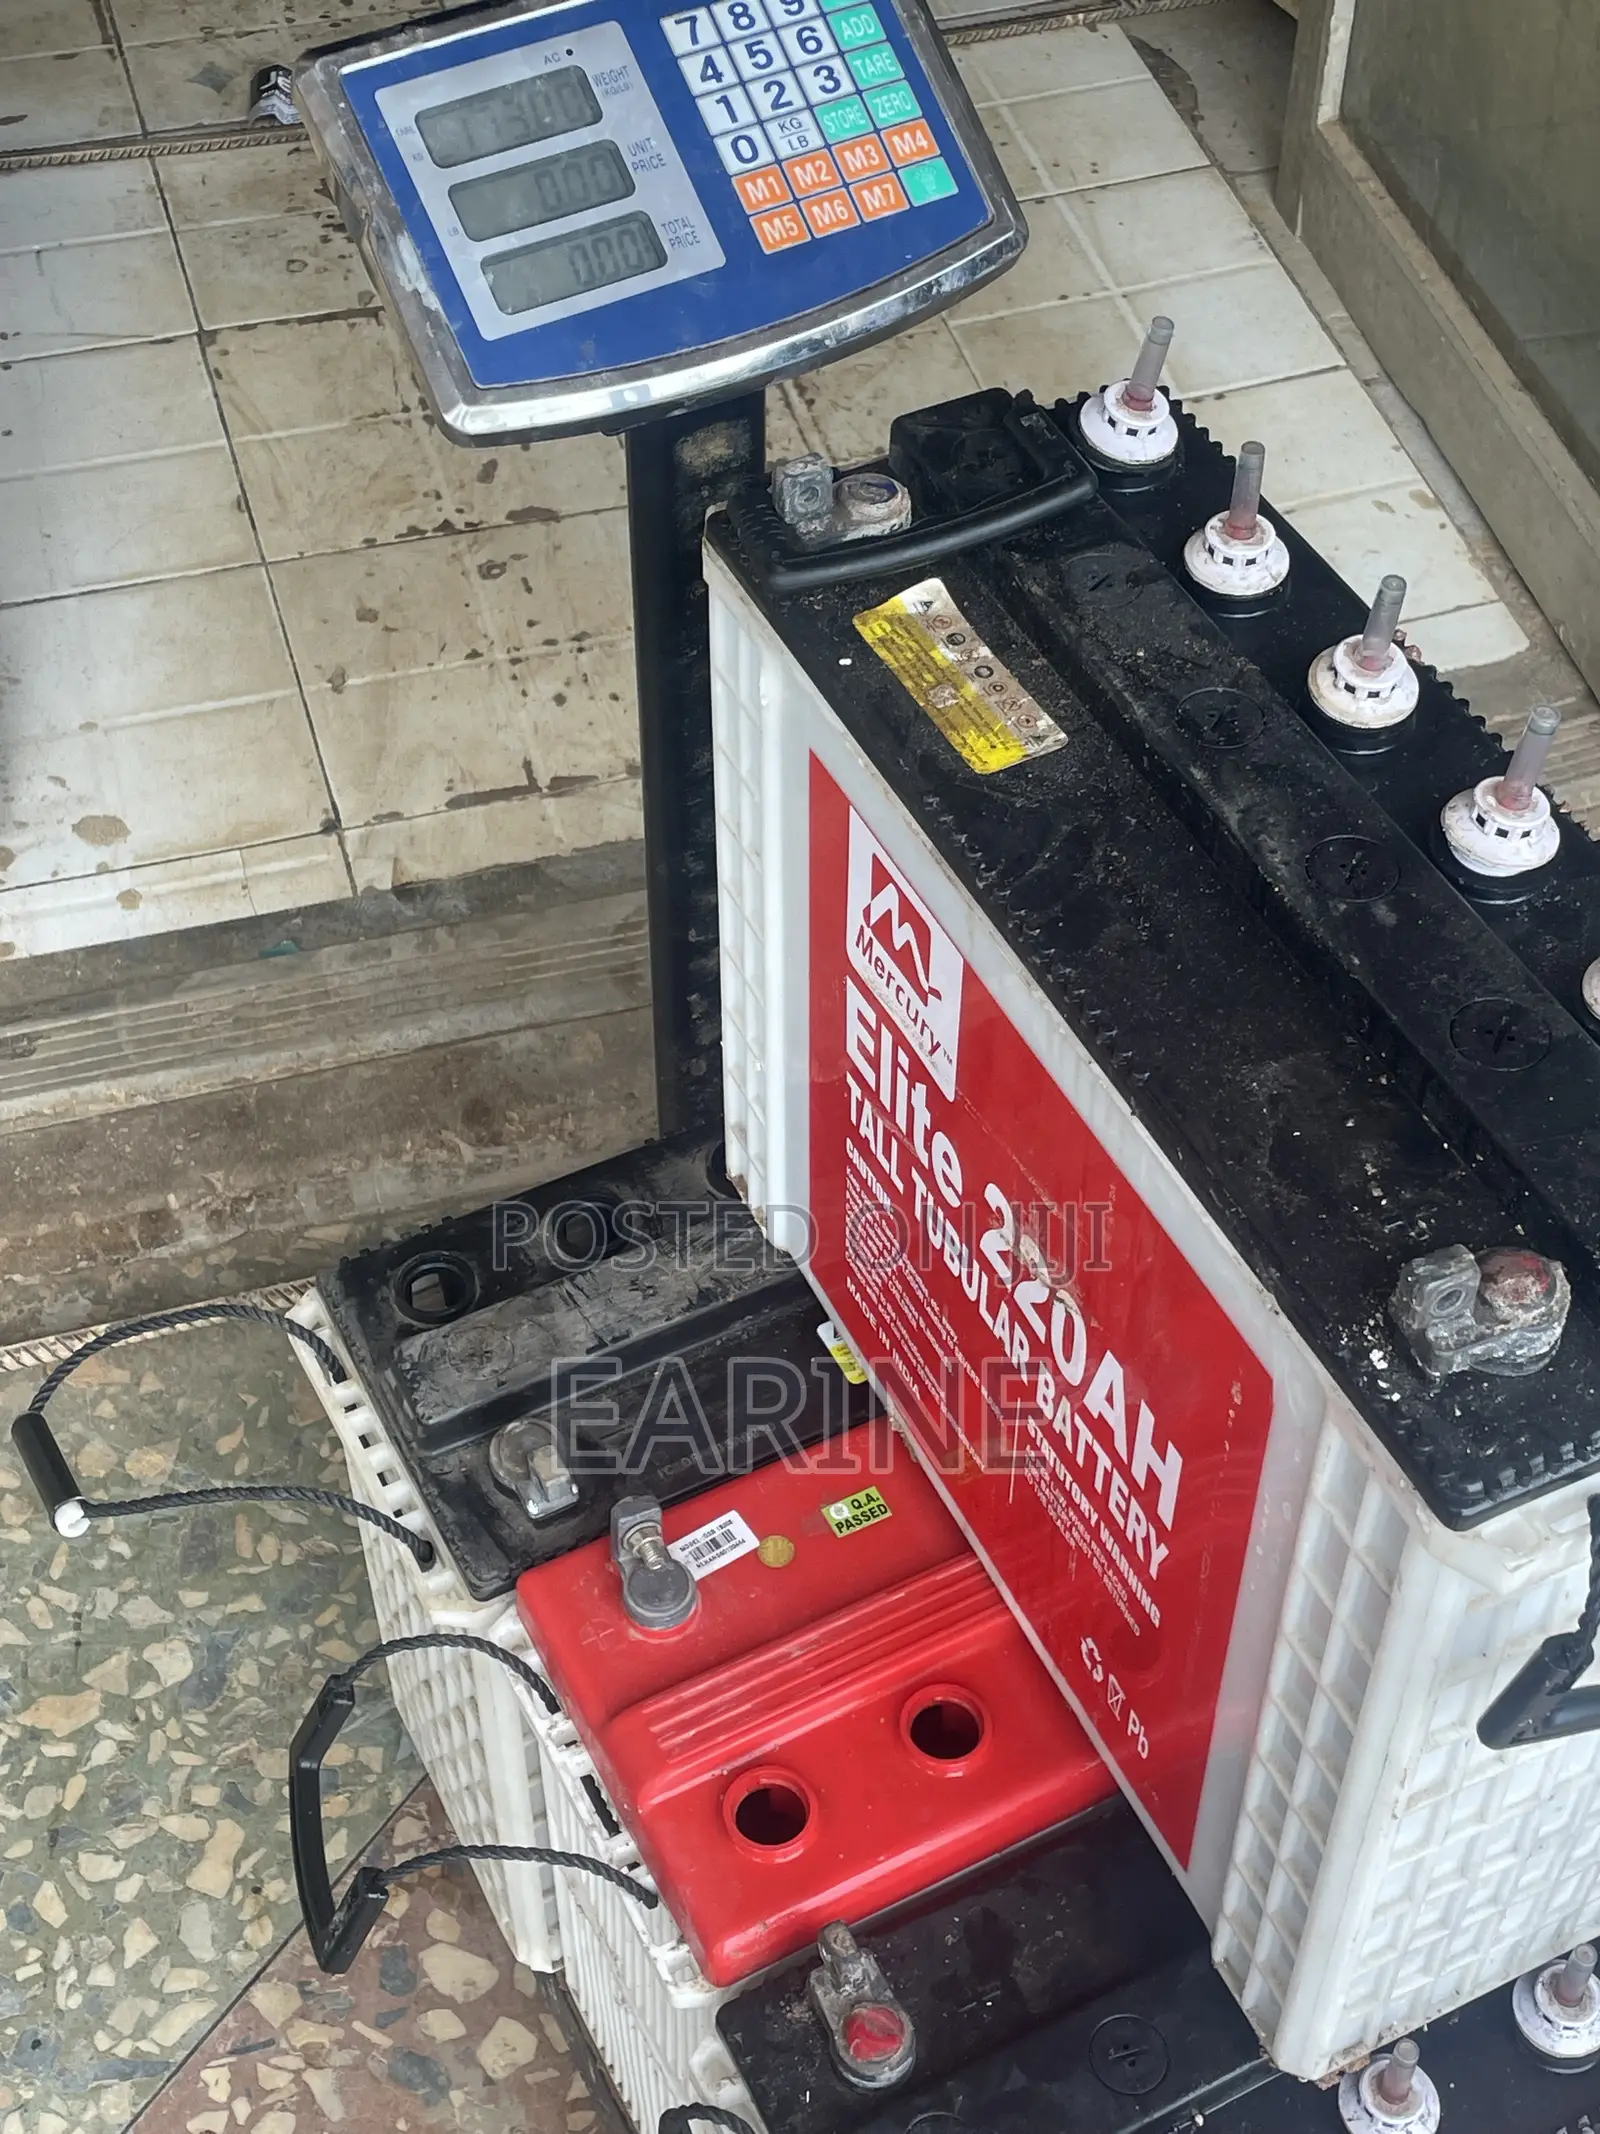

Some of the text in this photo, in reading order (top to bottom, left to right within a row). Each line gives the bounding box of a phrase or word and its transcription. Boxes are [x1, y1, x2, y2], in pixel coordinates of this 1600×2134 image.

[674, 15, 699, 46] 7
[727, 2, 756, 31] 8
[840, 13, 876, 37] ADD
[745, 40, 773, 70] 5
[796, 26, 823, 55] 6
[544, 53, 561, 65] AC
[700, 55, 723, 84] 4
[853, 50, 896, 75] TARE
[592, 66, 630, 88] WEIGHT
[813, 65, 841, 94] 3
[715, 95, 738, 124] 1
[763, 80, 794, 111] 2
[872, 93, 912, 119] ZERO
[779, 117, 802, 133] KG
[823, 105, 867, 133] STORE
[627, 138, 653, 157] UNIT
[731, 135, 758, 164] 0
[788, 135, 809, 151] LB
[891, 129, 929, 159] M4
[631, 153, 667, 174] PRICE
[842, 145, 881, 174] M3
[794, 160, 832, 189] M2
[744, 176, 781, 205] M1
[861, 184, 897, 213] M7
[660, 215, 695, 237] TOTAL
[811, 199, 849, 228] M6
[668, 230, 701, 250] PRICE
[761, 215, 798, 243] M5
[846, 974, 963, 1208] Elite
[980, 1182, 1183, 1532] 220AH
[847, 1074, 904, 1194] TALL
[911, 1169, 1029, 1382] TUBULAR
[1036, 1361, 1169, 1581] BATTERY
[847, 1274, 876, 1329] MADE
[879, 1326, 890, 1352] IN
[892, 1347, 920, 1400] INDIA
[850, 1493, 880, 1511] Q.A.
[835, 1504, 889, 1534] PASSED
[1027, 1415, 1161, 1628] STATUTORY WARNING
[1127, 1709, 1150, 1761] Pb
